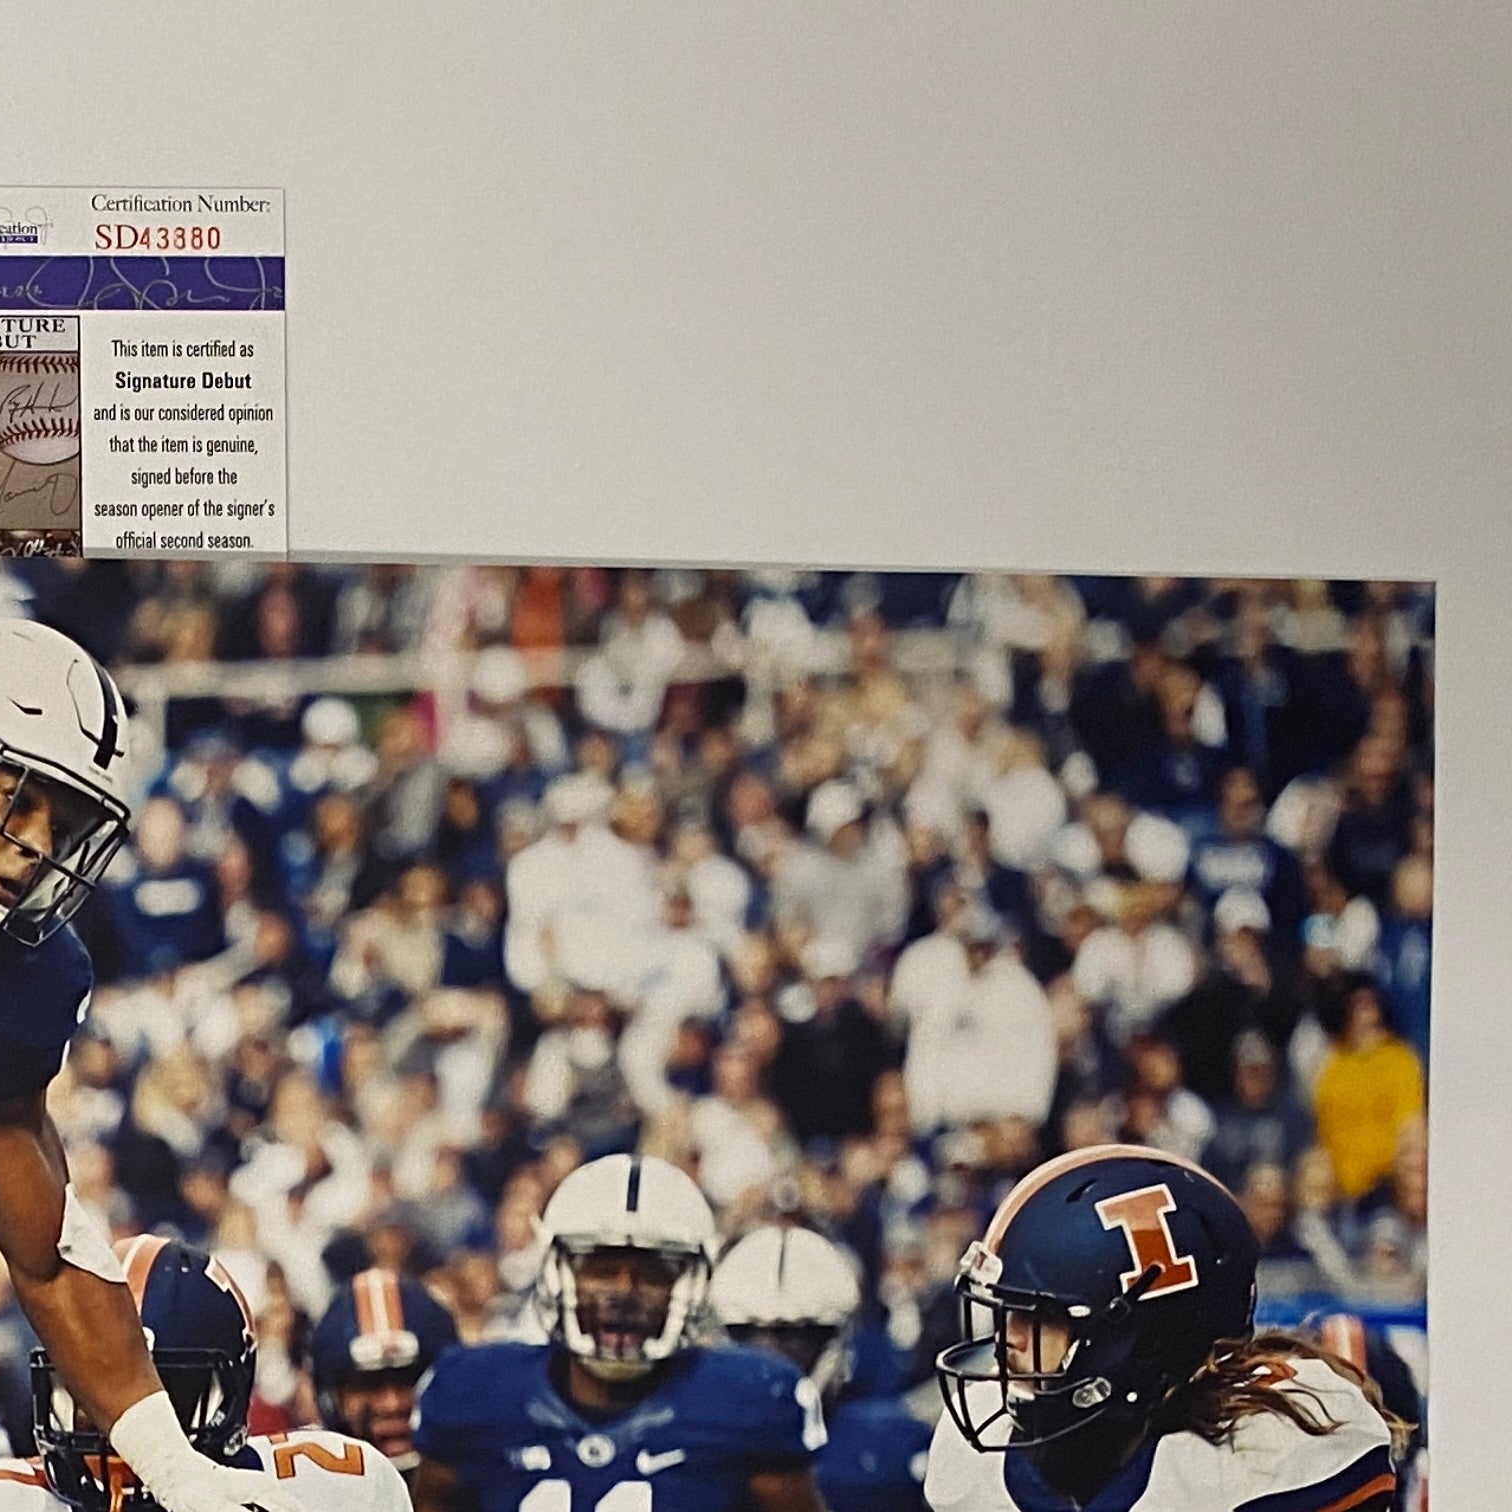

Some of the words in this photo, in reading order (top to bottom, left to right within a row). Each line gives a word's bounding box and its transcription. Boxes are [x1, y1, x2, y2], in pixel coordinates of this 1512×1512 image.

[91, 194, 192, 212] Certification
[197, 194, 271, 212] Number:
[95, 223, 221, 249] SD43880
[112, 339, 138, 357] This
[141, 339, 168, 357] item
[172, 339, 183, 357] is
[187, 339, 236, 357] certified
[239, 344, 254, 357] as
[115, 371, 196, 393] Signature
[202, 371, 252, 389] Debut
[93, 403, 117, 421] and
[120, 403, 131, 421] is
[134, 408, 155, 421] our
[158, 403, 224, 421] considered
[228, 403, 273, 425] opinion
[109, 435, 134, 453] that
[138, 435, 157, 453] the
[161, 435, 188, 453] item
[192, 435, 202, 453] is
[206, 435, 258, 456] genuine,
[131, 467, 171, 488] signed
[175, 467, 214, 485] before
[218, 467, 237, 485] the
[94, 503, 138, 517] season
[141, 503, 184, 521] opener
[188, 499, 200, 517] of
[203, 499, 223, 517] the
[227, 499, 275, 521] signer's
[116, 531, 156, 549] official
[160, 531, 203, 549] second
[207, 535, 254, 549] season.
